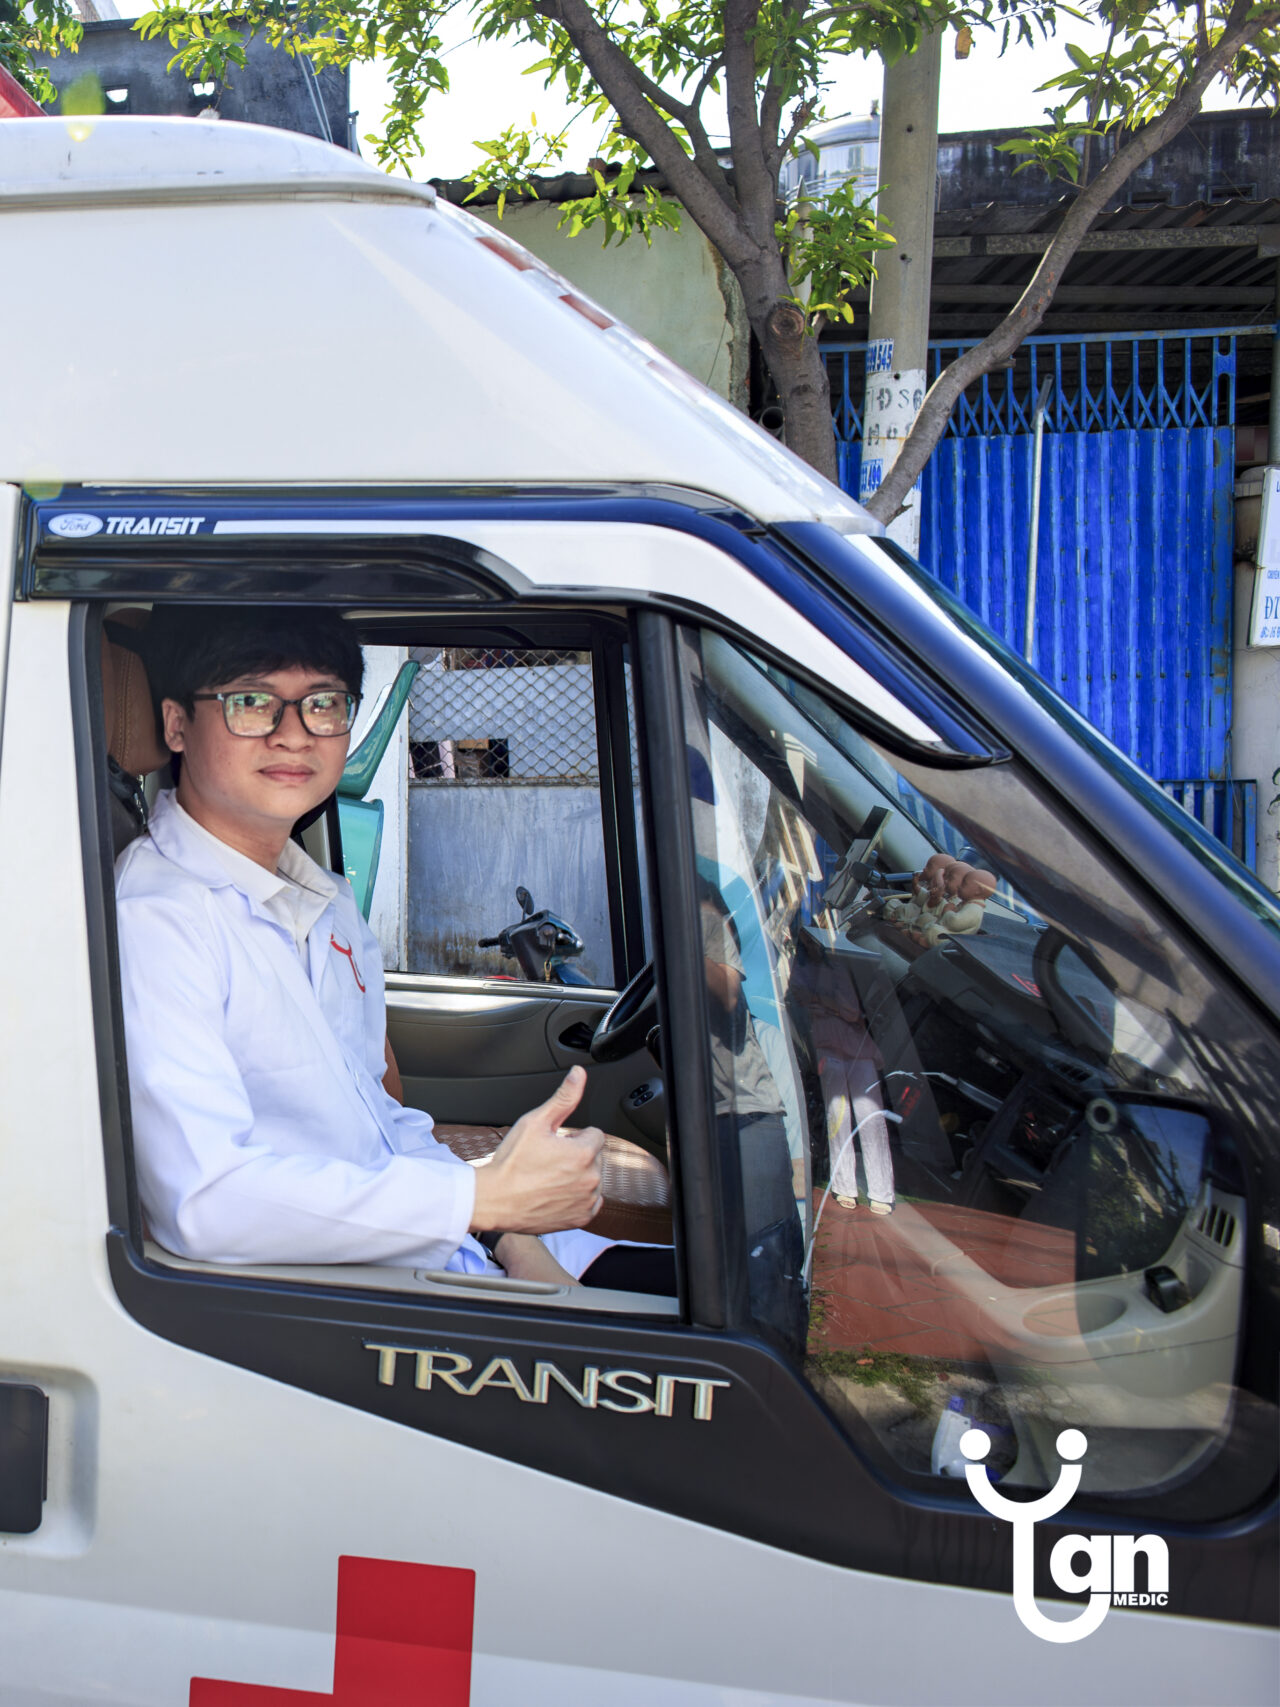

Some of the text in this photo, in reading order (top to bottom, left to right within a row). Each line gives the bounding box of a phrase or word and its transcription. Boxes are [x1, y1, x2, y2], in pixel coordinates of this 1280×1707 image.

[59, 516, 206, 535] Ford TRANSIT
[362, 1340, 732, 1421] TRANSIT
